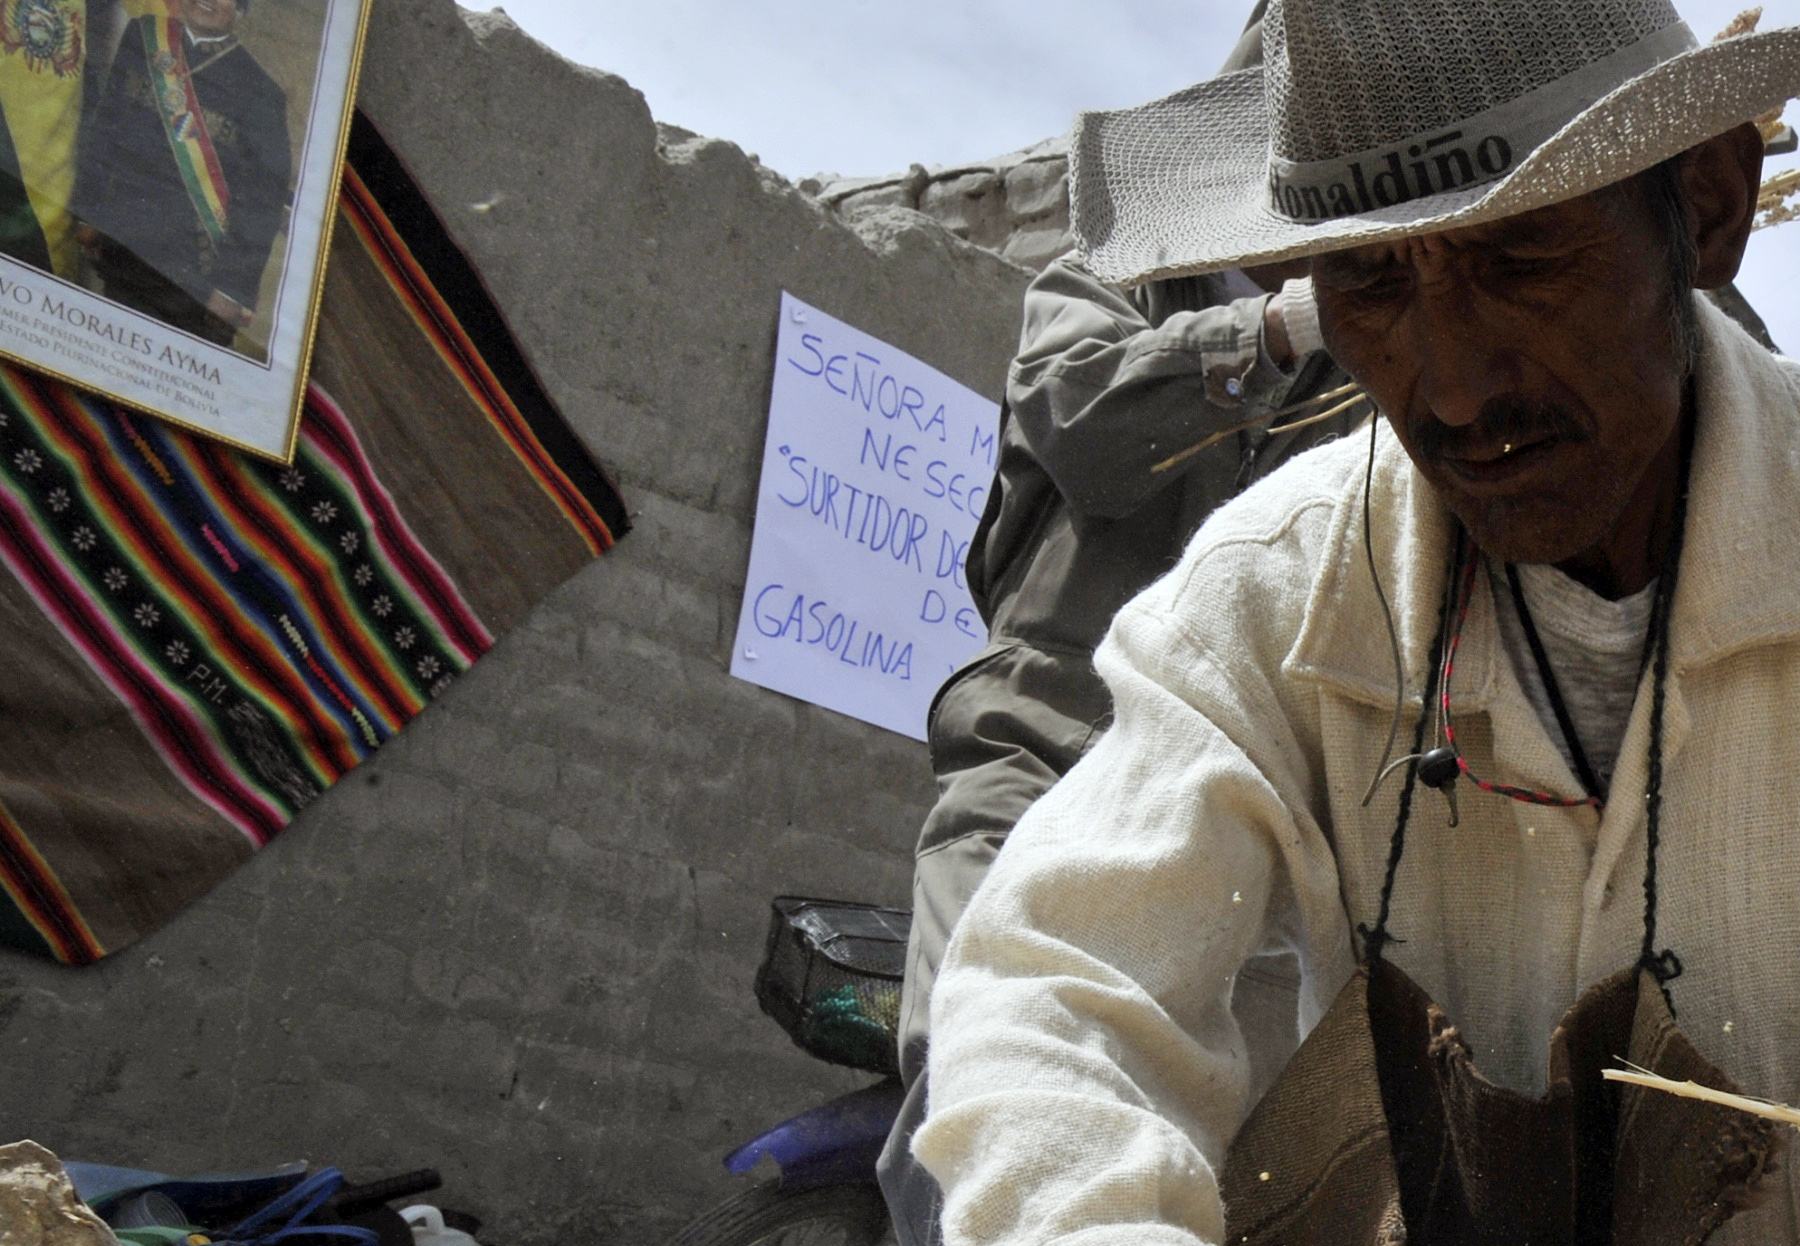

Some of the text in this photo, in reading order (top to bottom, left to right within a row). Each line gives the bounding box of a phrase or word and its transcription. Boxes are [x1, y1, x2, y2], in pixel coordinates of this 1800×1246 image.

[0, 321, 220, 417] ESTADO PLURINACIONAL DE BOLIVIA
[33, 318, 108, 357] PRESIDENTE
[111, 350, 215, 401] CONSTITUCIONAL
[41, 295, 153, 355] MORALES
[158, 344, 221, 385] AYMA
[788, 333, 947, 442] SEÑORA
[754, 584, 914, 680] GASOLINA
[920, 589, 977, 638] DE
